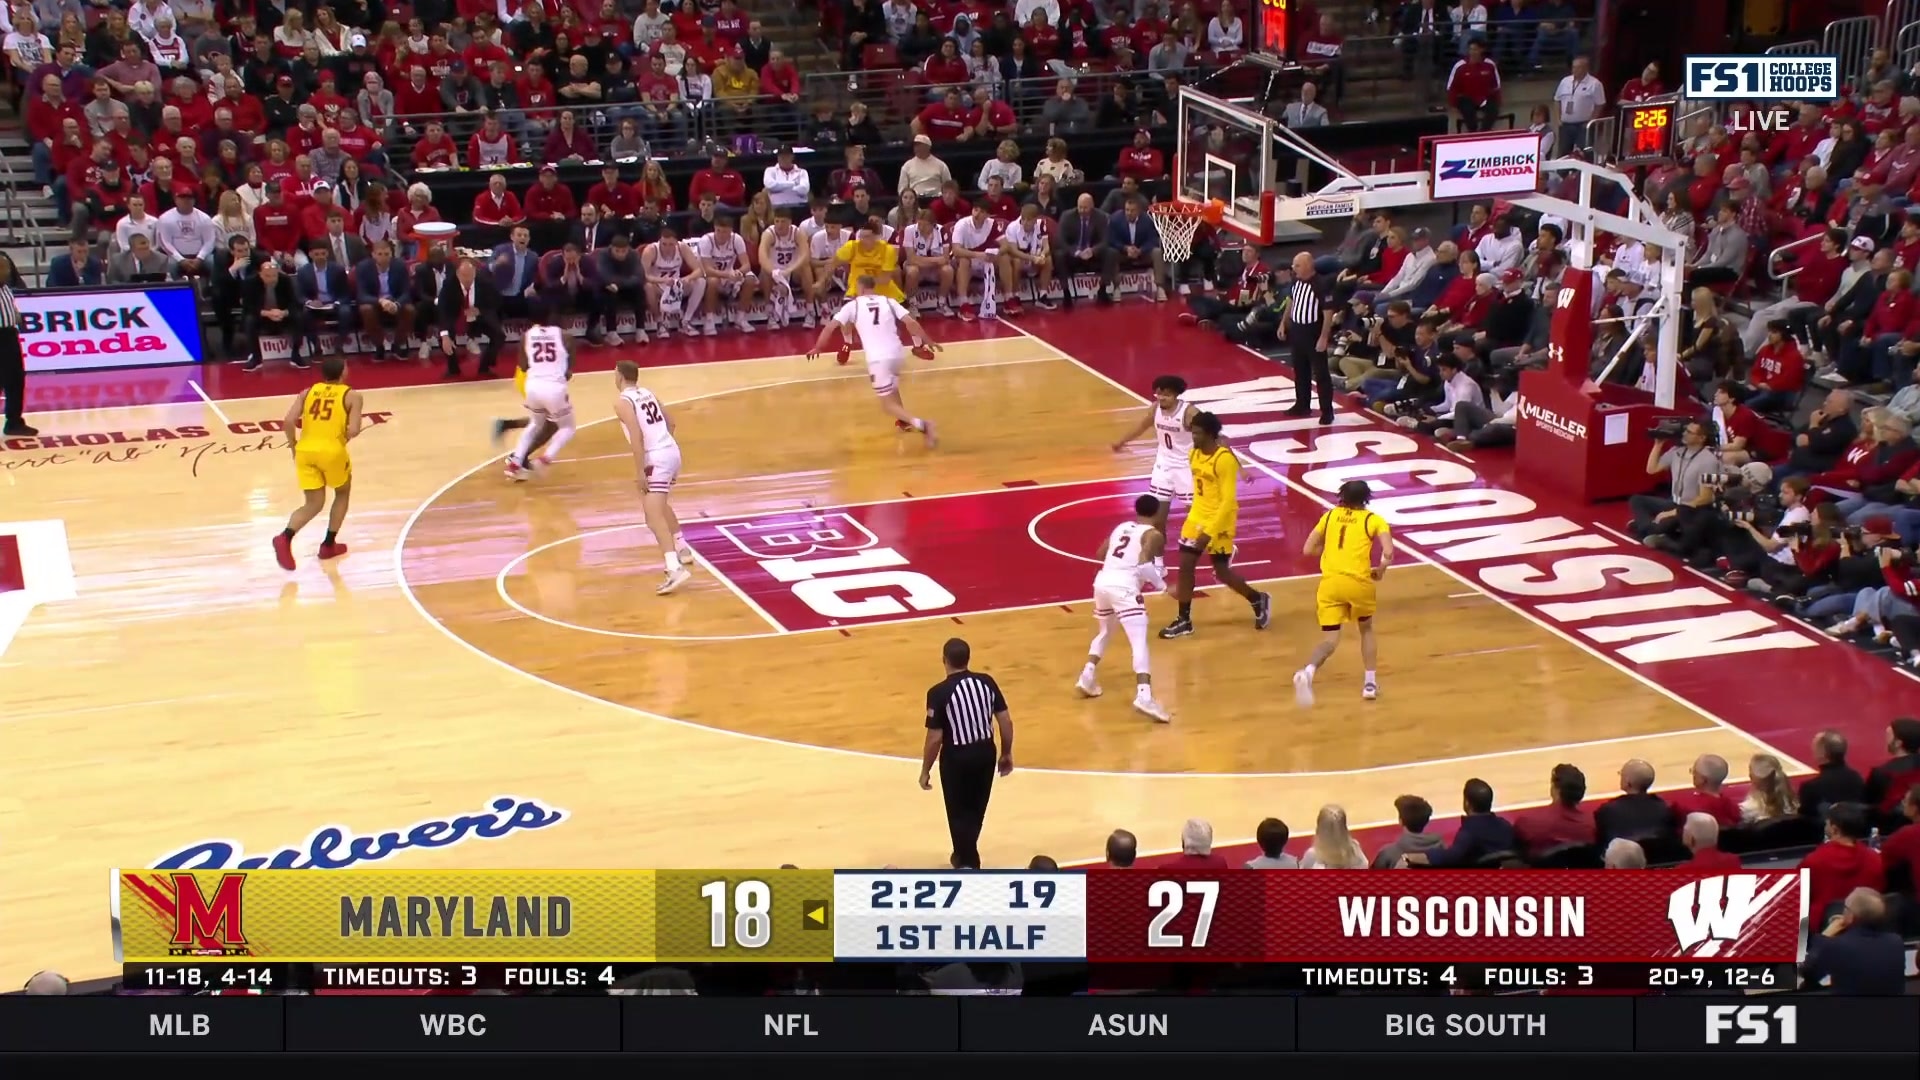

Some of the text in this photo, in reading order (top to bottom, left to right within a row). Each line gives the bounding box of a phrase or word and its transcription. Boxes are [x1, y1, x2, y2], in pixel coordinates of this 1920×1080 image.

[1633, 109, 1667, 129] 2:26
[1467, 153, 1535, 169] ZIMBRICK
[1479, 166, 1534, 178] HONDA
[777, 252, 793, 265] 23
[1557, 287, 1576, 309] W
[18, 306, 149, 334] BRICK
[868, 306, 880, 325] 7
[532, 342, 557, 362] 25
[309, 398, 334, 420] 45
[641, 401, 663, 425] 32
[0, 411, 393, 451] CHOLAS COT
[1526, 402, 1588, 439] MUELLER
[1164, 432, 1173, 450] 0
[1178, 375, 1820, 665] WISCONSIN
[1111, 535, 1131, 559] 2
[1338, 525, 1347, 550] 1
